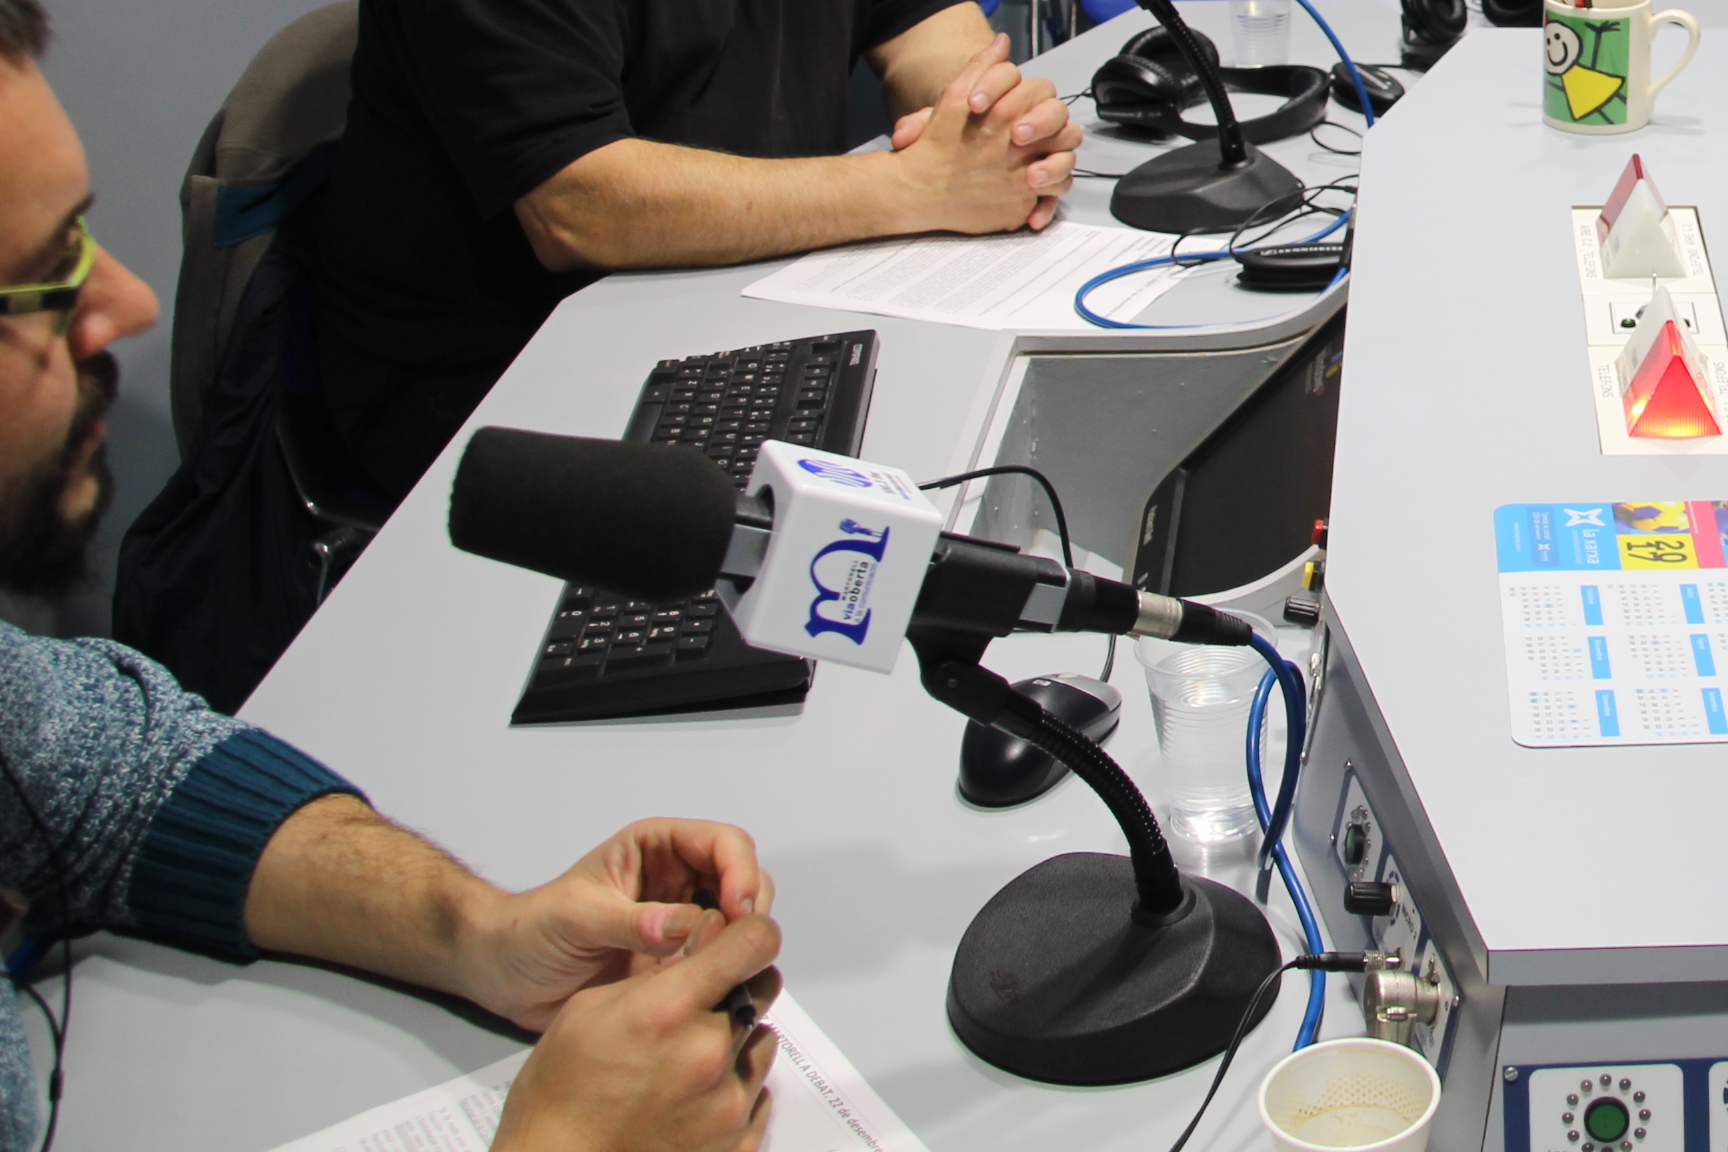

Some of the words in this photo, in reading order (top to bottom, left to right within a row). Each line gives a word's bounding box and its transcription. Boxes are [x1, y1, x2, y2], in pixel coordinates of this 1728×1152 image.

[1598, 364, 1615, 398] TELEFONS
[1585, 539, 1600, 565] xarxa
[843, 561, 869, 620] viaoberta
[828, 1097, 844, 1109] 22
[837, 1107, 851, 1119] de
